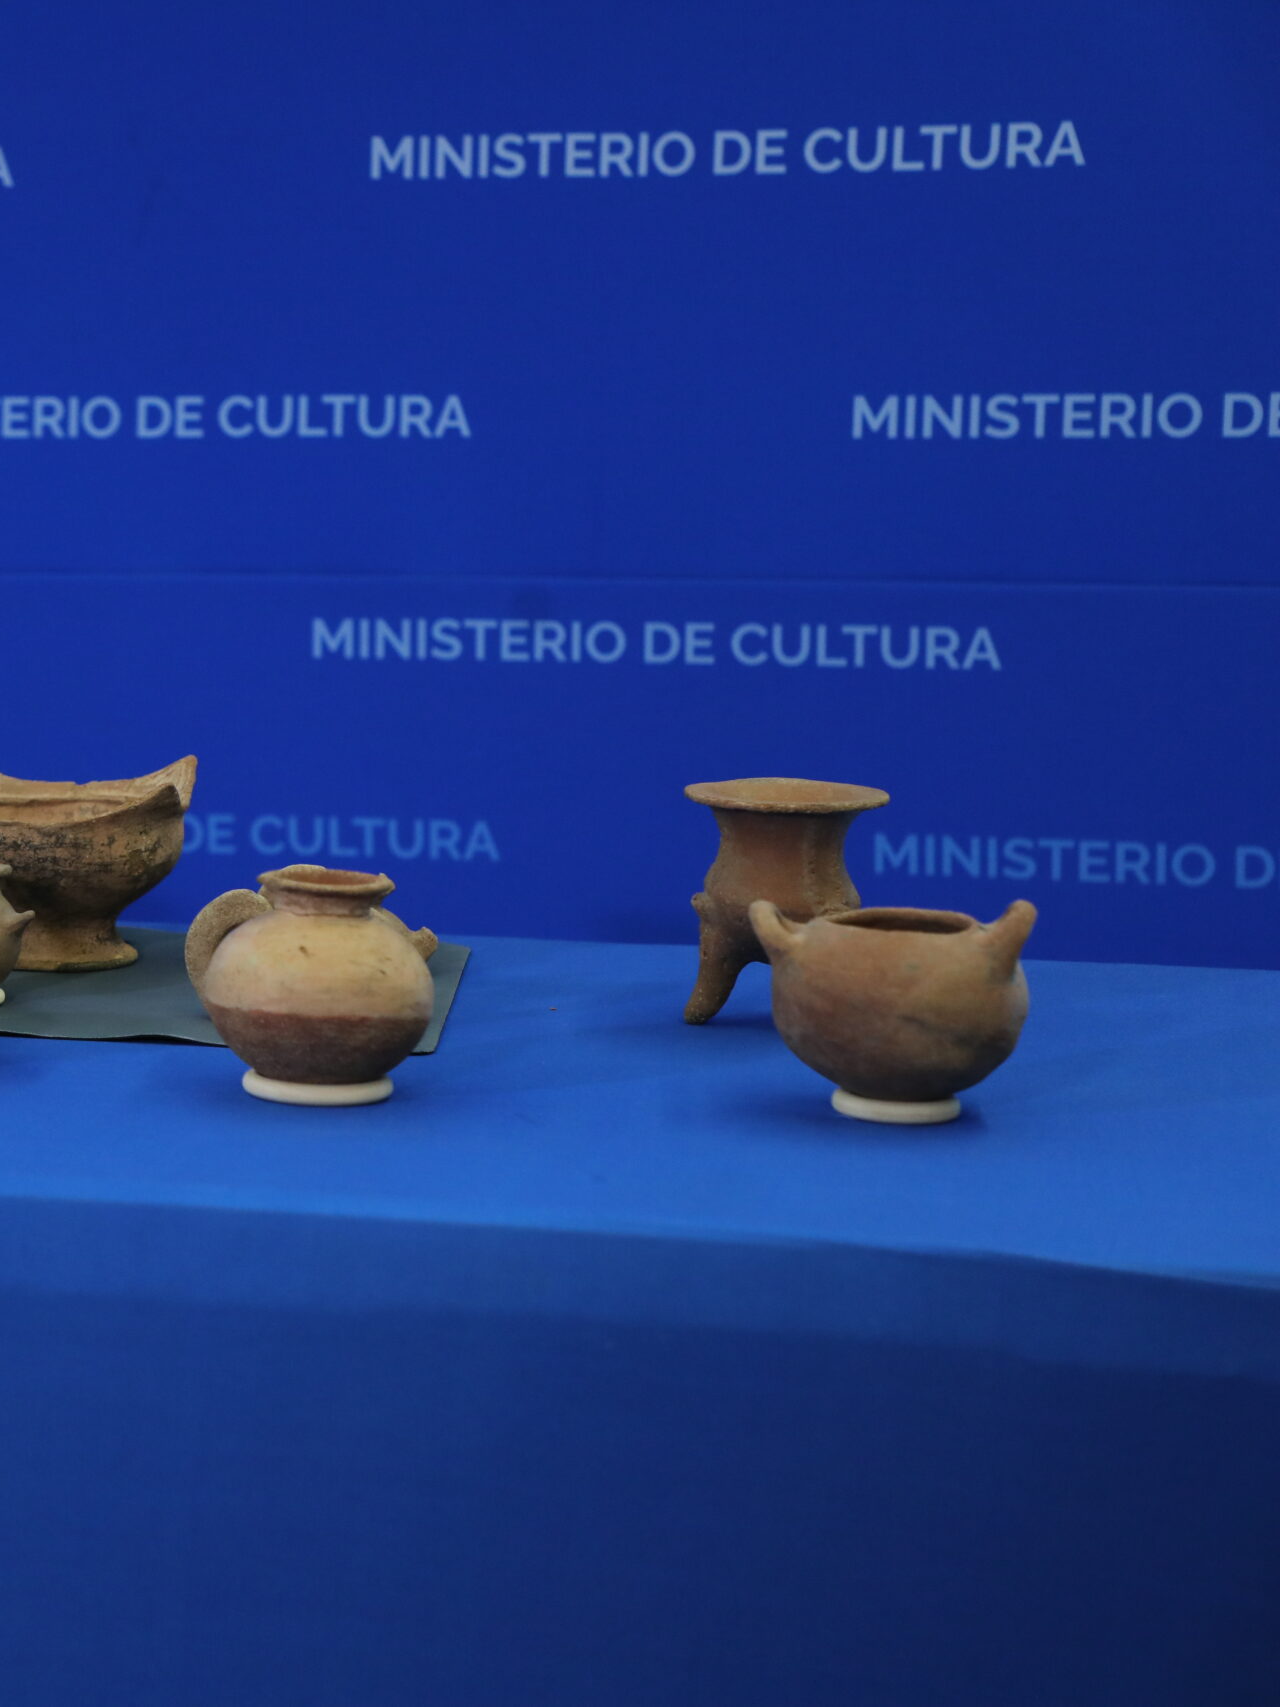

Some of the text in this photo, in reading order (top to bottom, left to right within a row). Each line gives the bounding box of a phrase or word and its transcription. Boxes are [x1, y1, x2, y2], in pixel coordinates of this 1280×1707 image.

[369, 120, 1087, 180] MINISTERIO DE CULTURA
[135, 394, 205, 440] DE
[217, 393, 471, 439] CULTURA
[851, 392, 1203, 440] MINISTERIO
[312, 617, 1002, 671] MINISTERIO DE CULTURA
[250, 814, 500, 863] CULTURA
[873, 833, 1216, 888] MINISTERIO
